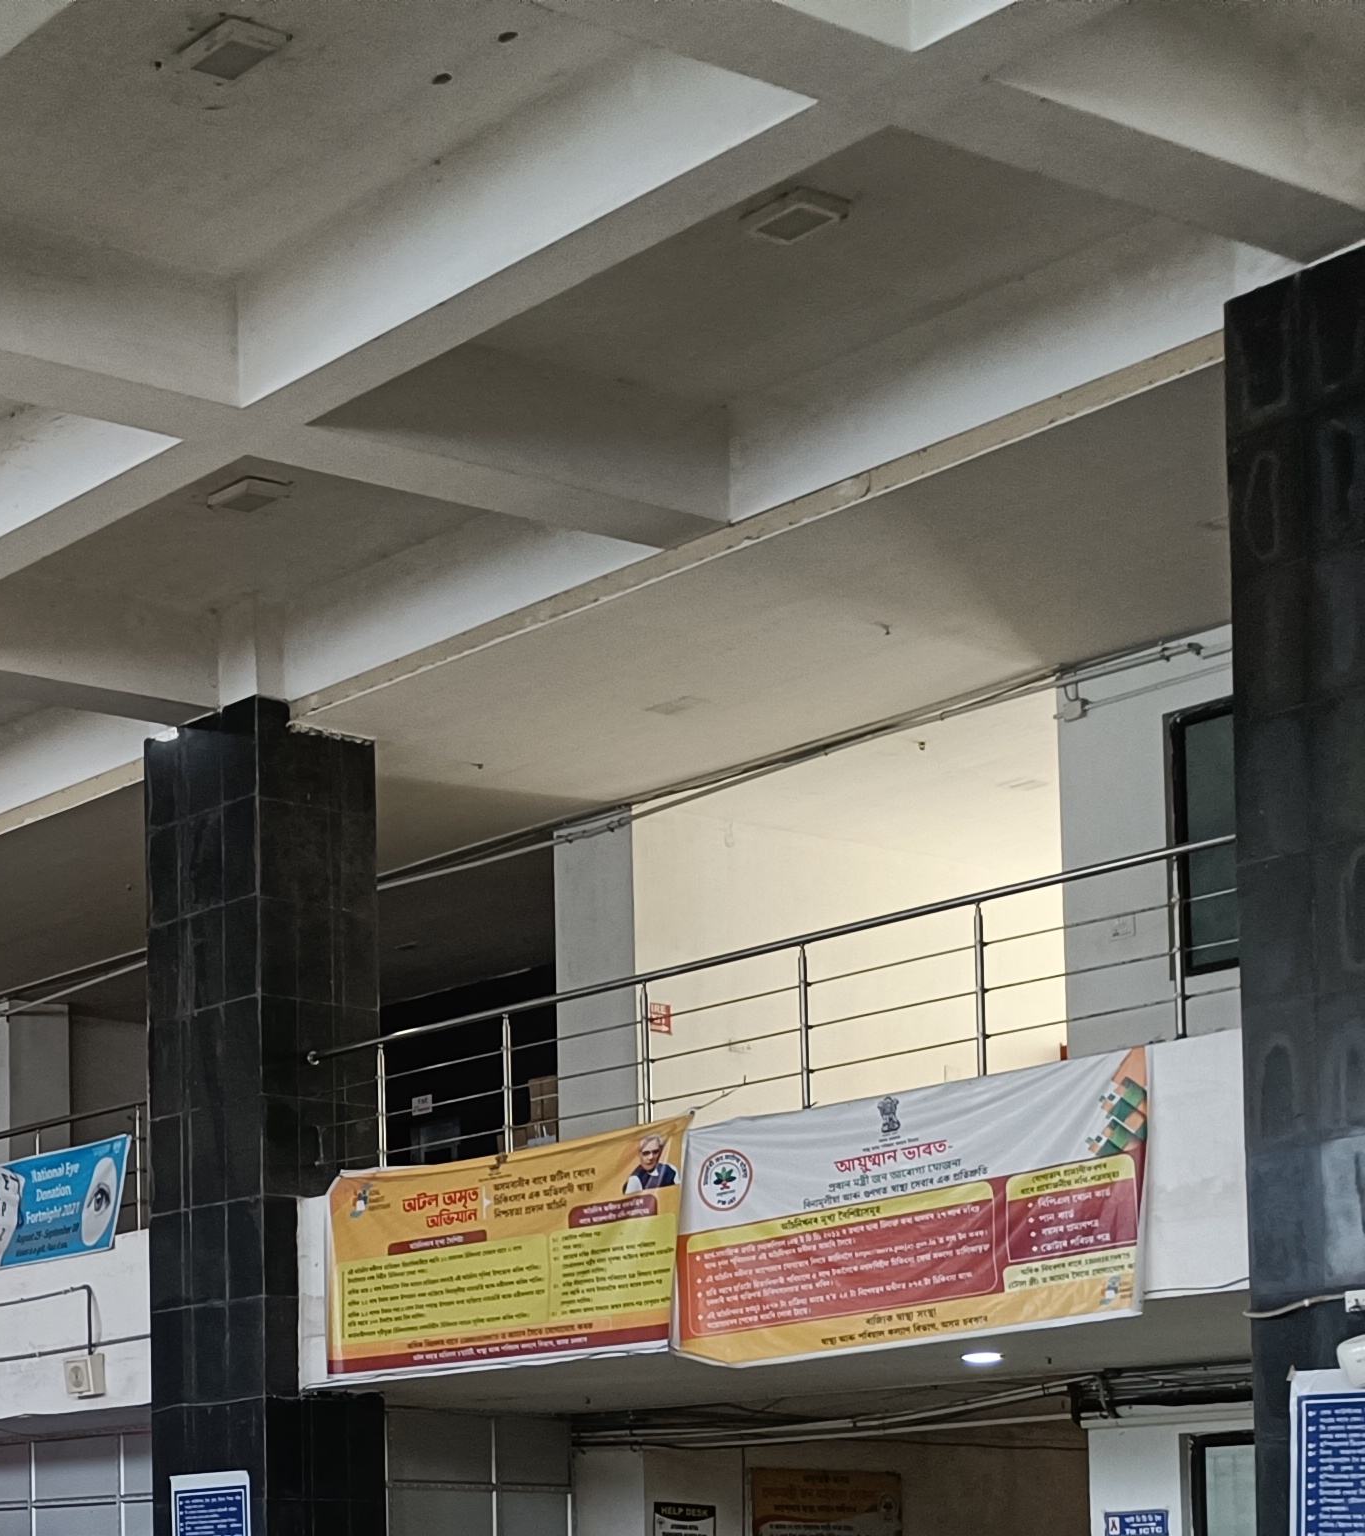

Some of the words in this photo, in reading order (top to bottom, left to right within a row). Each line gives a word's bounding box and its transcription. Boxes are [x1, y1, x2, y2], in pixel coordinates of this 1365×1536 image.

[30, 1162, 64, 1183] National
[65, 1161, 80, 1178] Eye
[36, 1184, 71, 1202] Donation
[402, 1193, 439, 1213] অটল
[442, 1188, 479, 1210] অমৃত
[25, 1206, 63, 1225] Fortnight
[426, 1208, 478, 1229] অভিযান
[661, 1506, 684, 1515] HELP
[685, 1507, 709, 1517] DESK
[1139, 1526, 1163, 1534] ICTC
